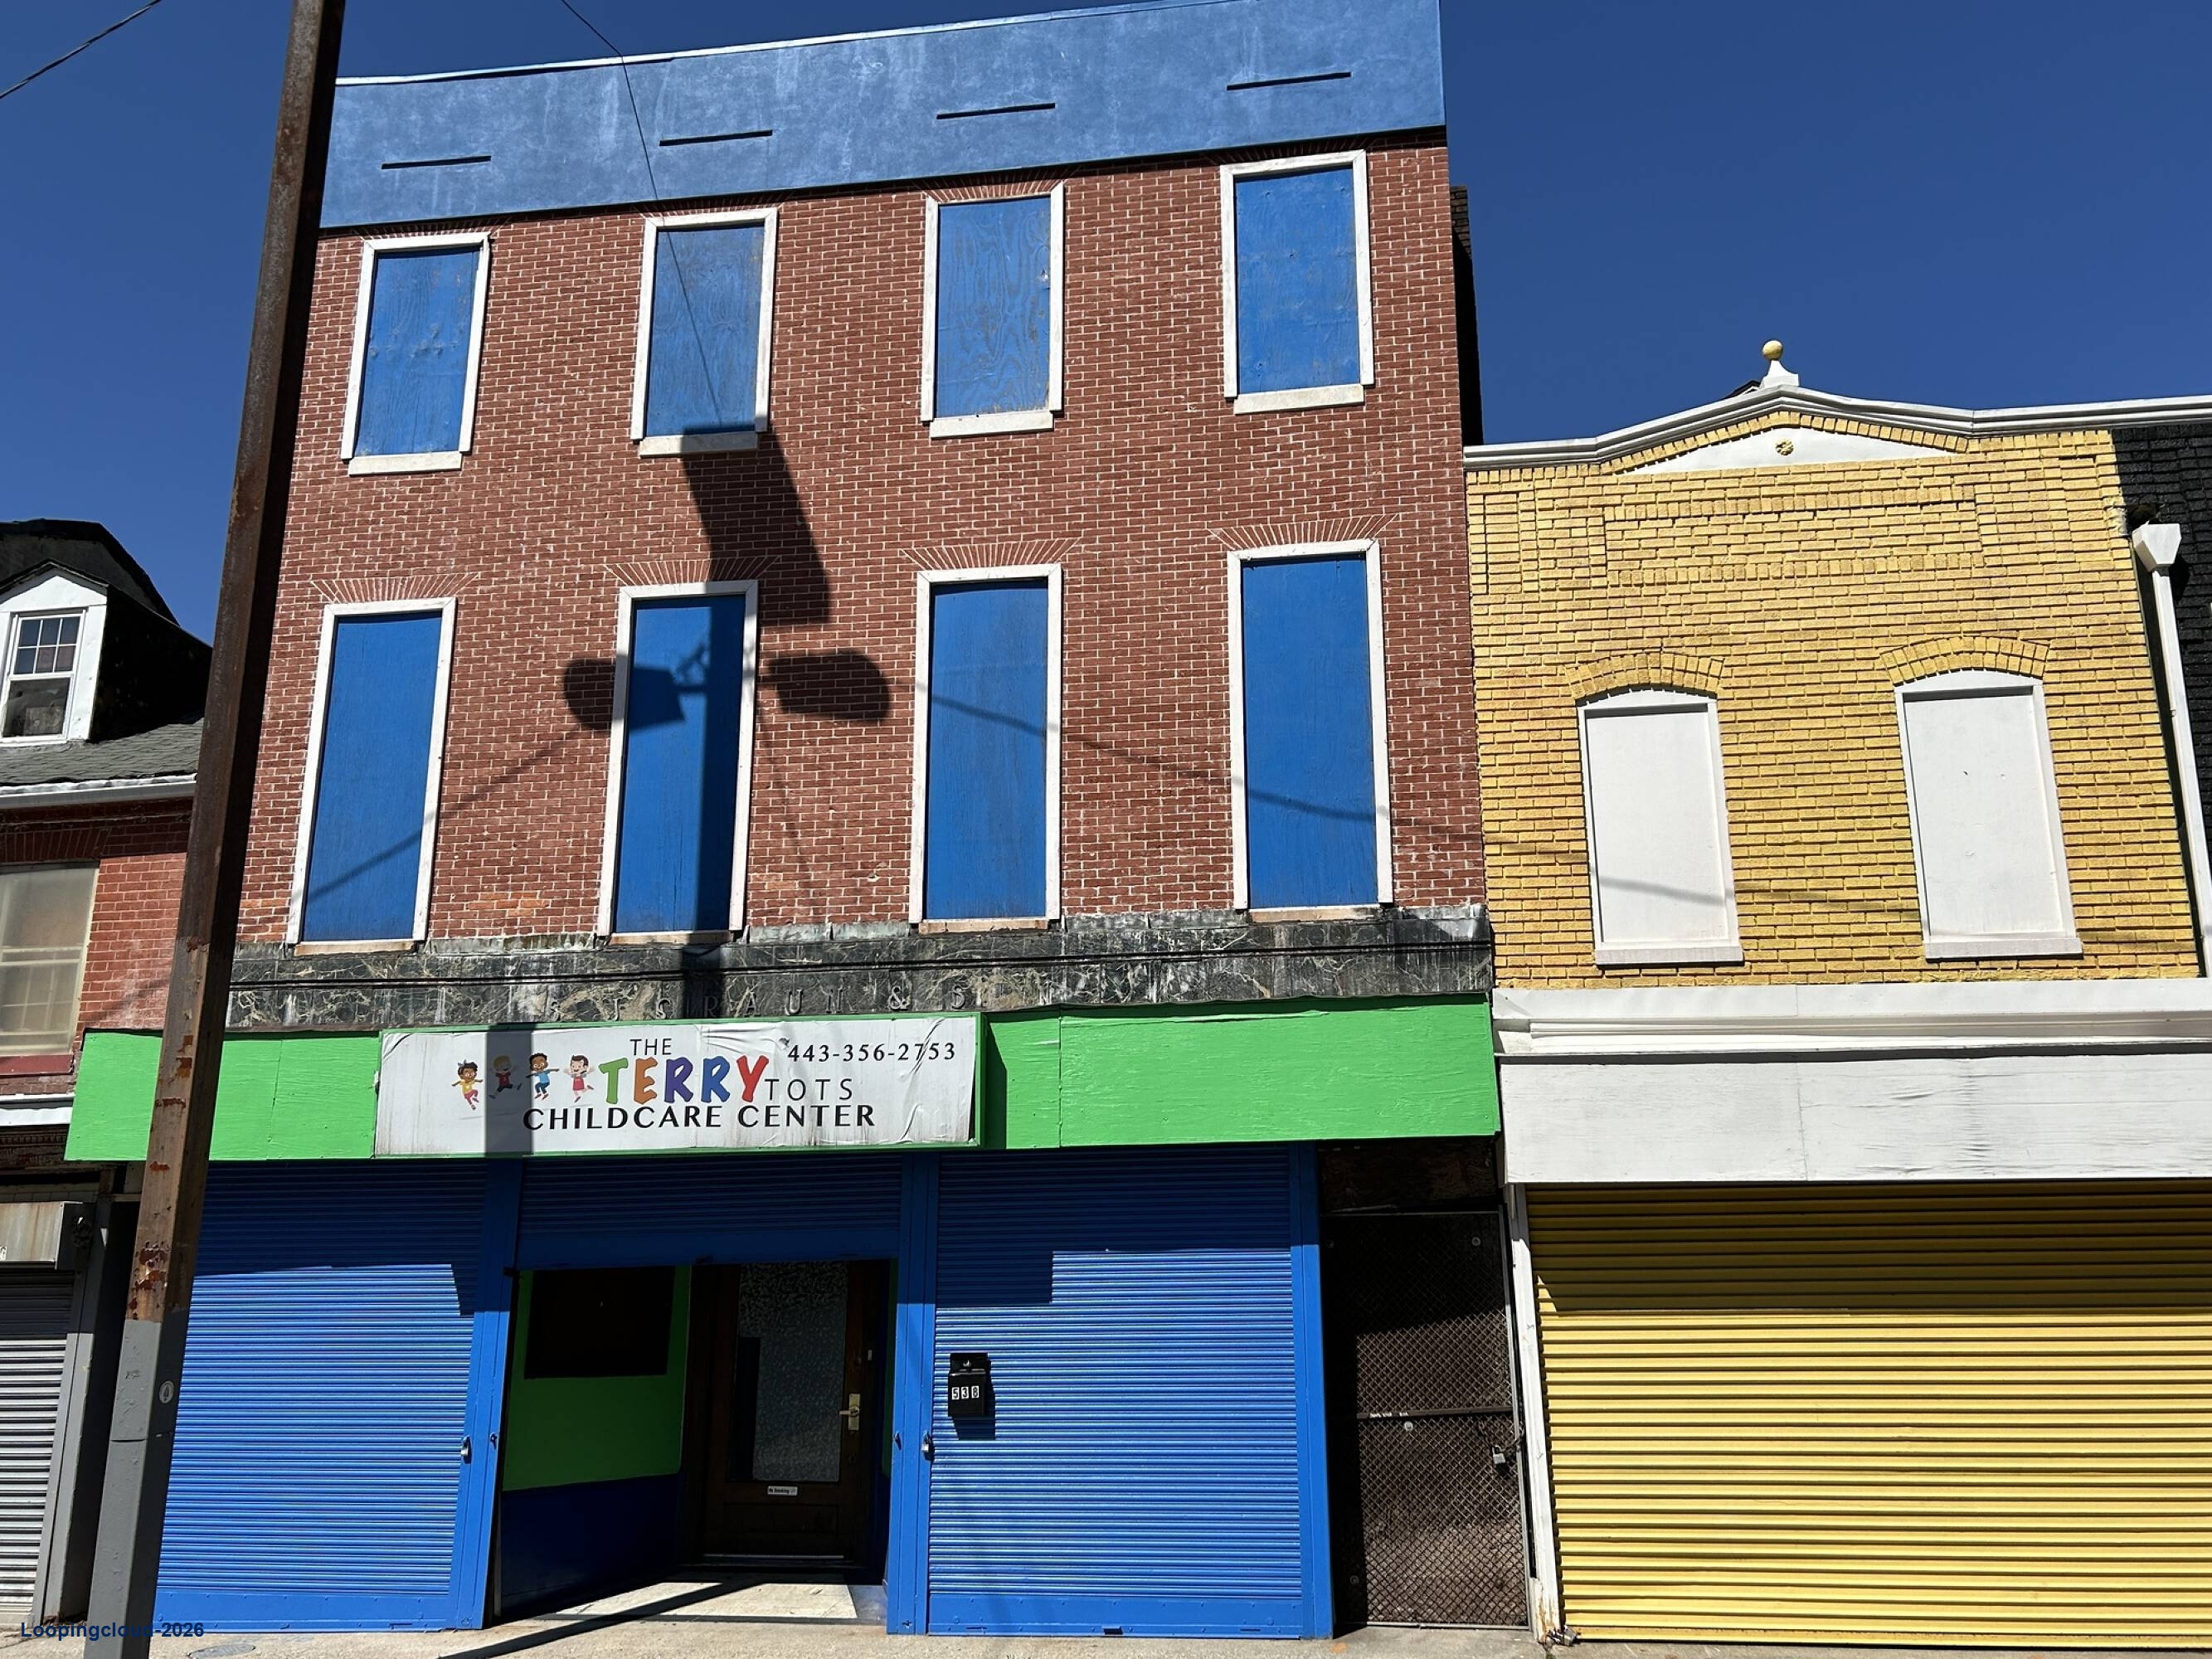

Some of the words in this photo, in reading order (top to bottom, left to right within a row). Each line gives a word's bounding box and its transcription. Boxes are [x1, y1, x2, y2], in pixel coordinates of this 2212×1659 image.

[630, 1039, 672, 1055] THE
[787, 1043, 955, 1061] 443-356-2753
[599, 1055, 770, 1104] TERRY
[765, 1078, 853, 1102] TOTS
[523, 1106, 722, 1130] CHILDCARE
[737, 1105, 875, 1128] CENTER
[952, 1386, 979, 1399] 538
